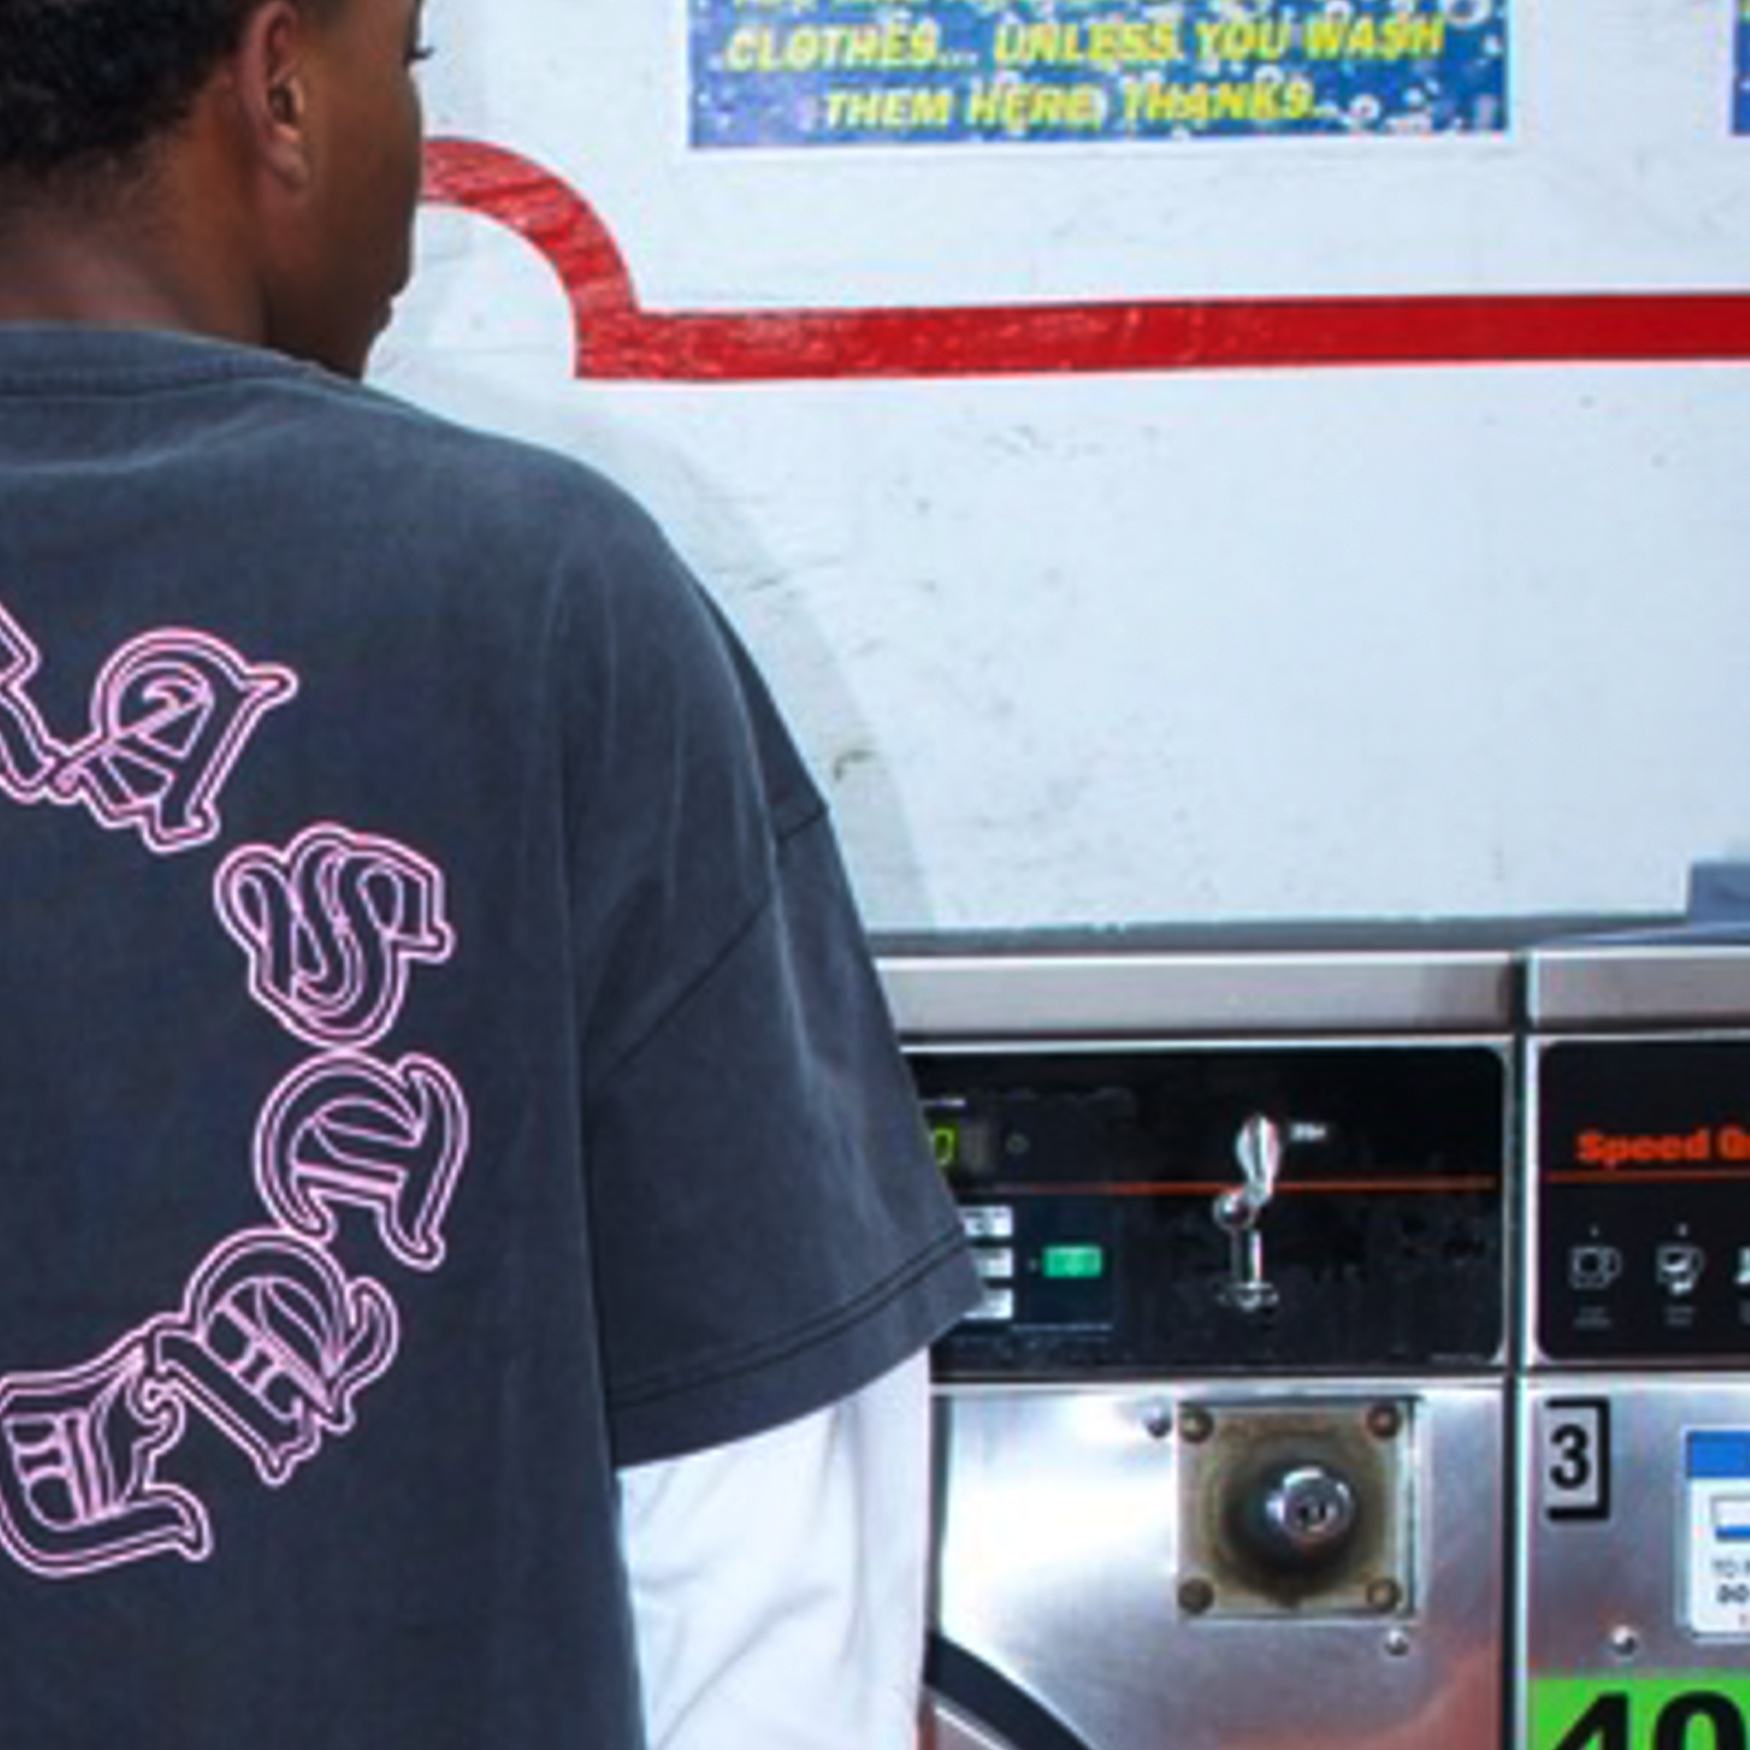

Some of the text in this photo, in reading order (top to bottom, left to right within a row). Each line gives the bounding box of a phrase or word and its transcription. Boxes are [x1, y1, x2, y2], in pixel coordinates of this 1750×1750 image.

[992, 14, 1182, 66] UNLESS
[1192, 13, 1290, 62] YOU
[1300, 10, 1445, 60] WASH
[823, 86, 952, 130] THEM
[1576, 1126, 1709, 1170] Speed
[1550, 1424, 1590, 1491] 3
